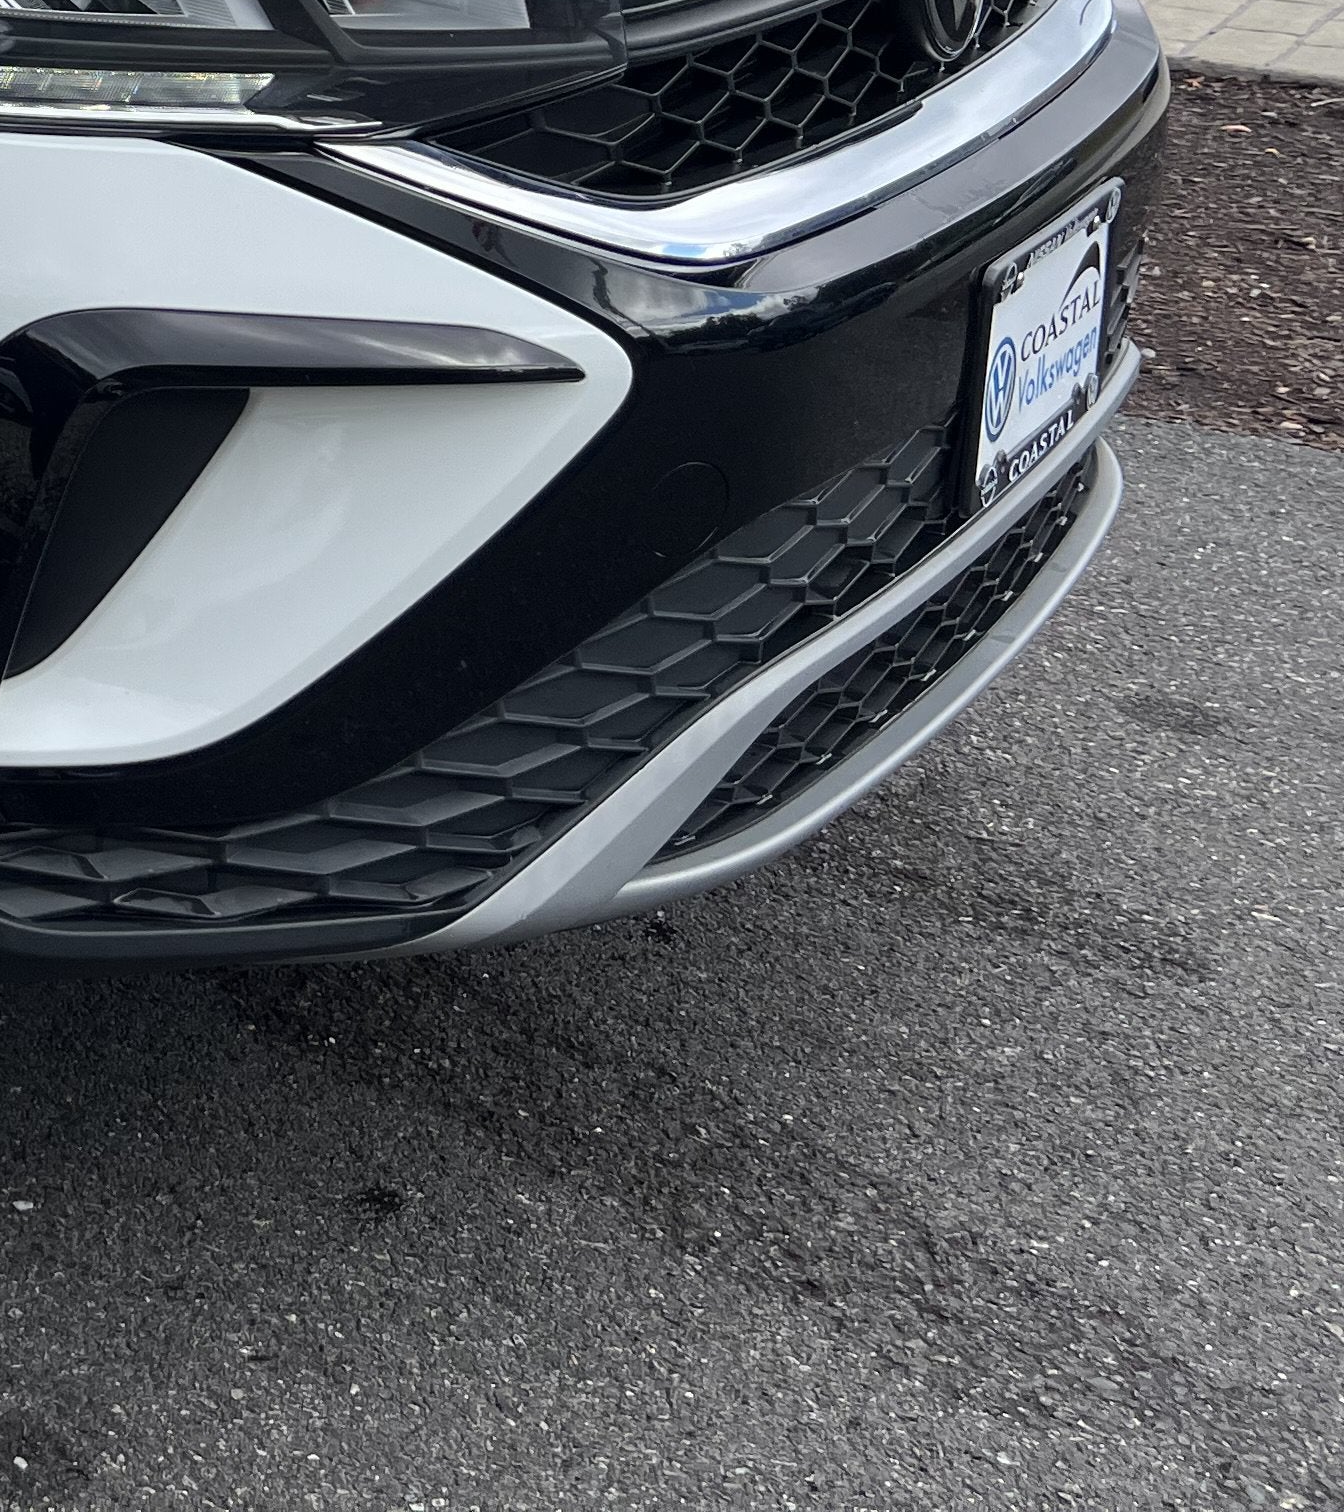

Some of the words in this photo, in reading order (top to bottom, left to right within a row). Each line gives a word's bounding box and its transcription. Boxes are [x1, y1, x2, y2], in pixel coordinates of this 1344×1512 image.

[1021, 280, 1100, 362] COASTAL
[1018, 326, 1097, 413] Volkswagen
[1008, 409, 1075, 483] COASTAL
